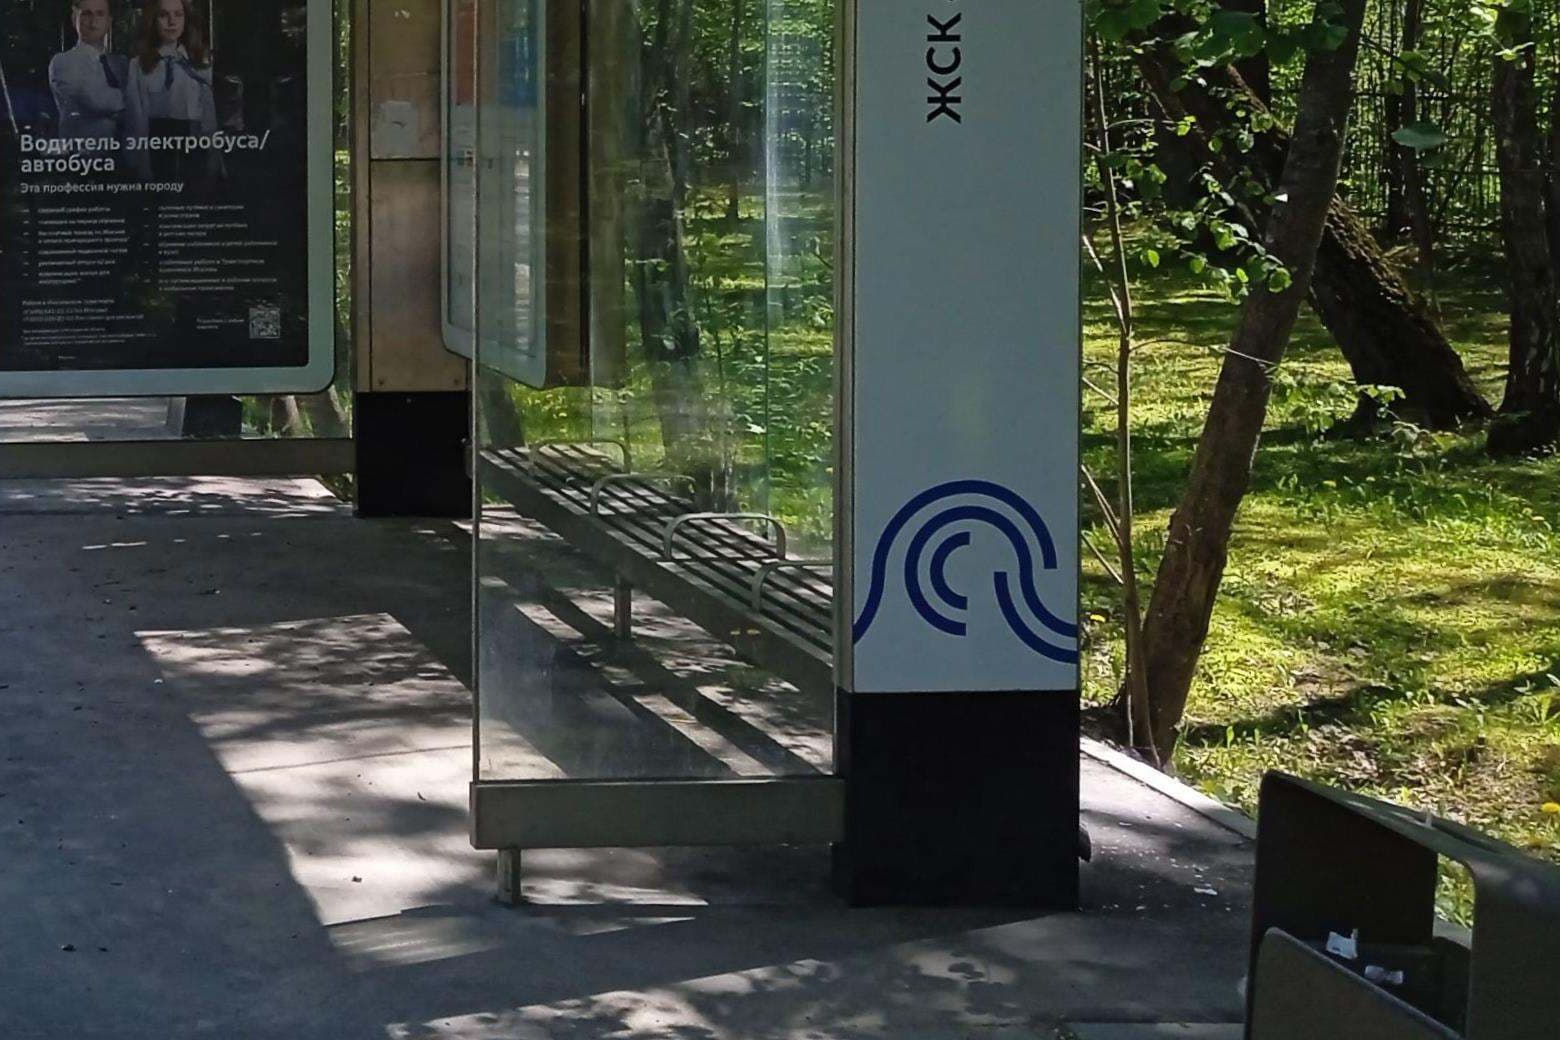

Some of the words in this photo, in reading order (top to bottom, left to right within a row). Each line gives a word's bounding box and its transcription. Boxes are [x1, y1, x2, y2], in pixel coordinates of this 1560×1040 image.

[926, 12, 963, 124] ЖСК
[20, 134, 121, 154] Водитель
[126, 130, 271, 154] электробуса/
[20, 155, 115, 176] автобуса
[20, 182, 41, 194] Эта
[43, 182, 104, 196] профессия
[106, 182, 142, 195] нужна
[144, 181, 185, 194] городу
